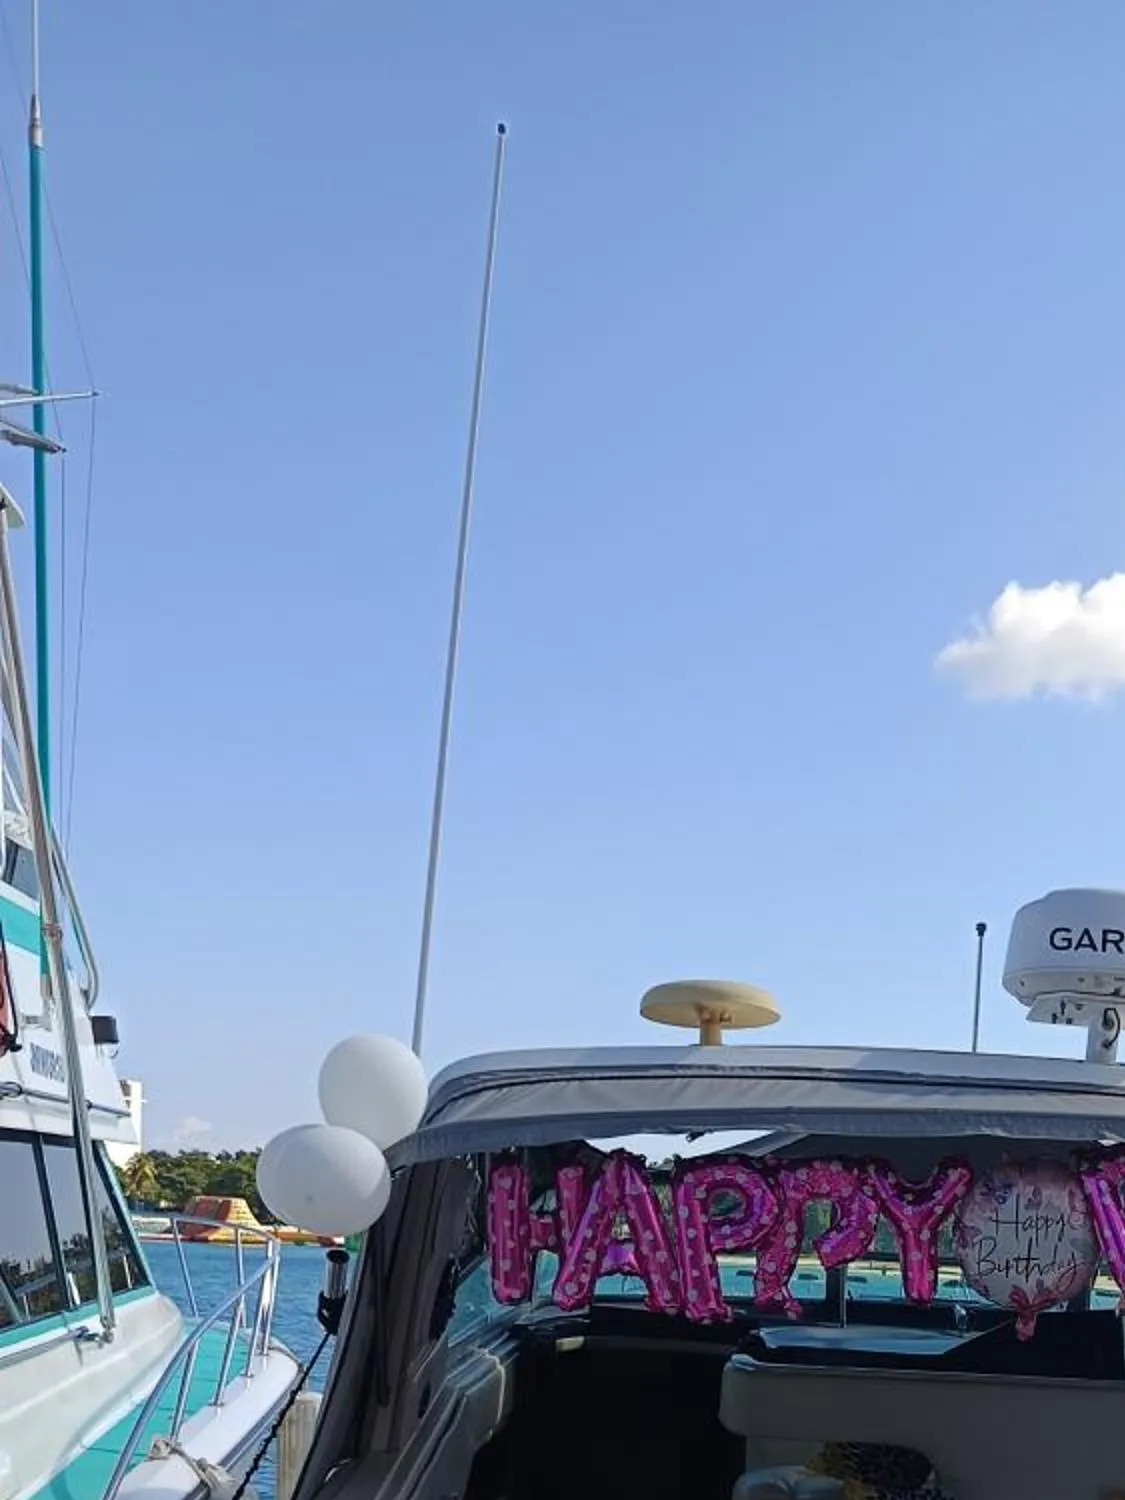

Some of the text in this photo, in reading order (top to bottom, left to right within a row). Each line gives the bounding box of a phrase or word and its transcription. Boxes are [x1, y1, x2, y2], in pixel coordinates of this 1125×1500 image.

[488, 1152, 972, 1325] HAPPY
[990, 1193, 1066, 1247] Happy
[973, 1236, 1078, 1296] Birthday
